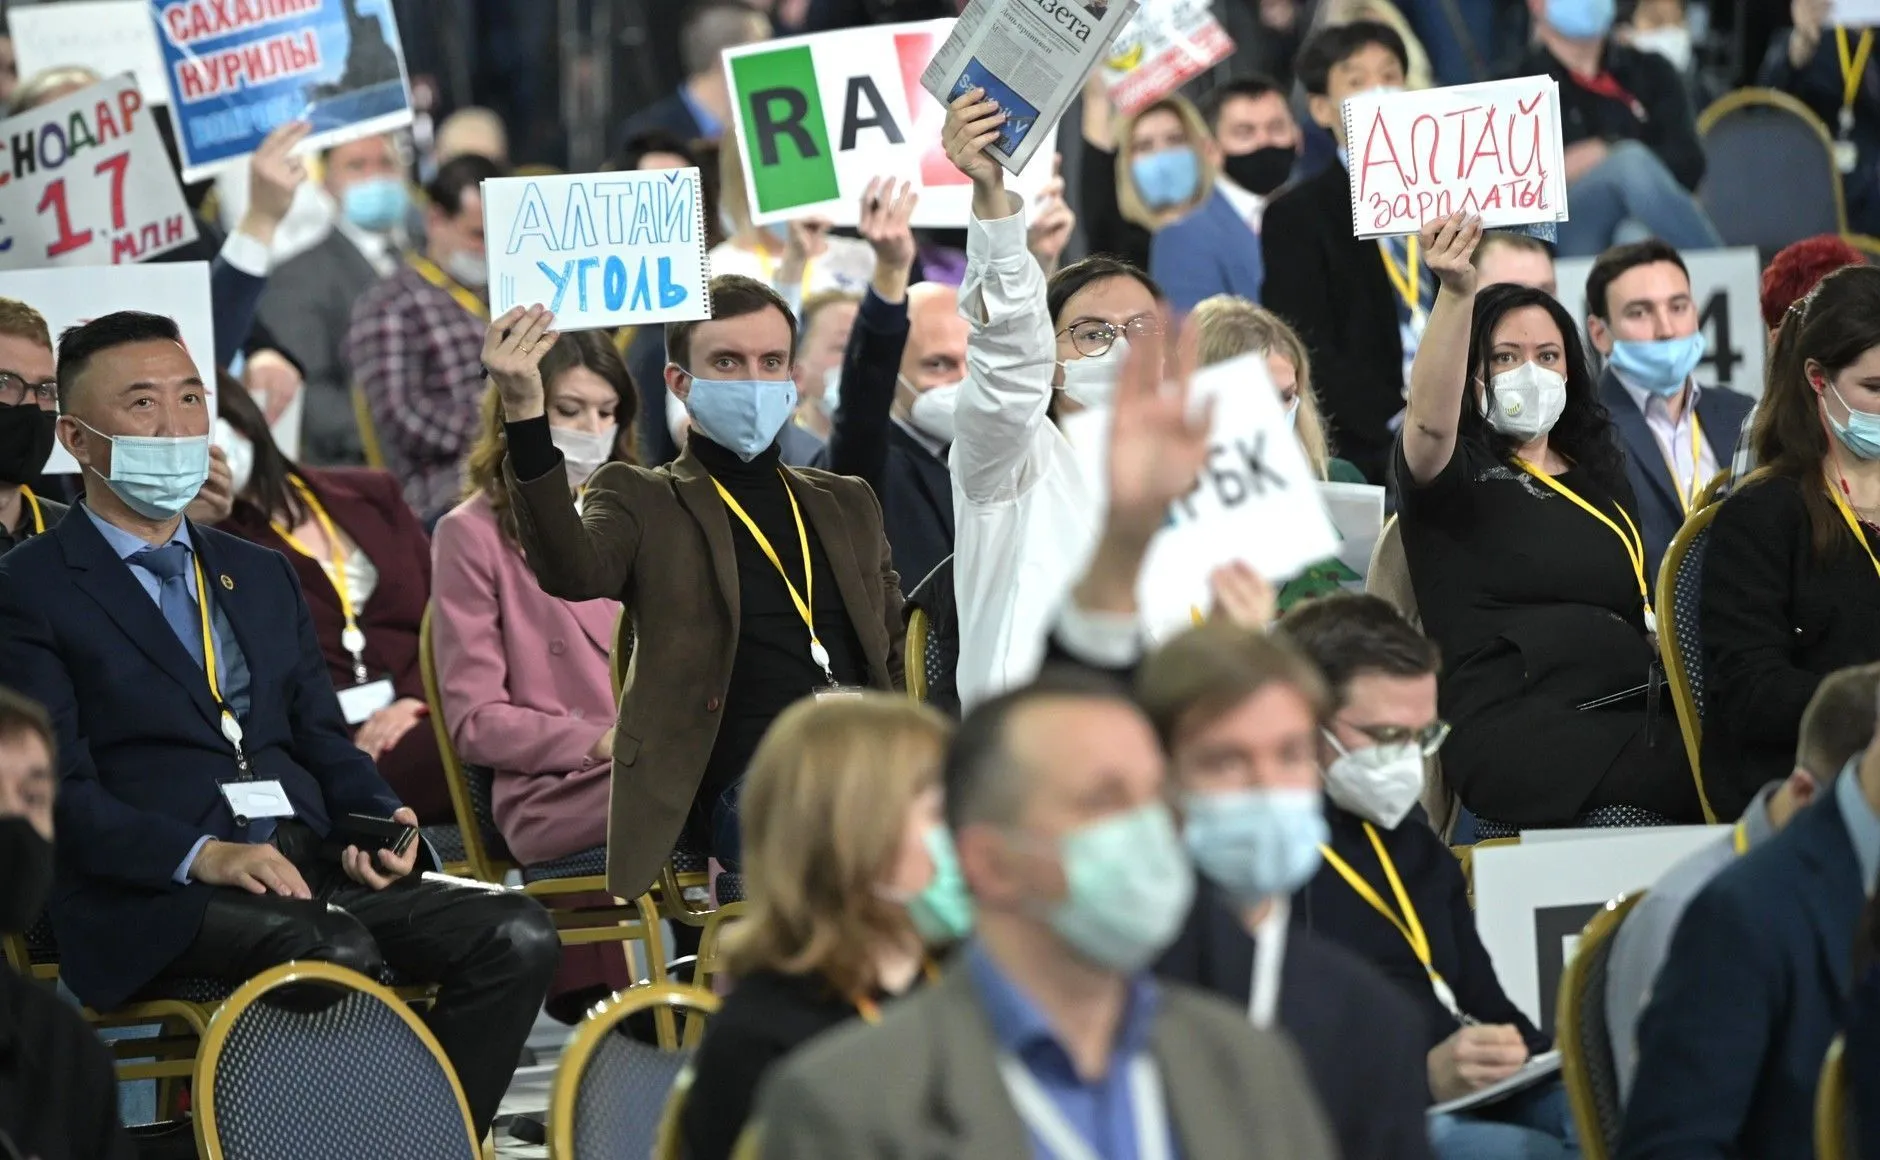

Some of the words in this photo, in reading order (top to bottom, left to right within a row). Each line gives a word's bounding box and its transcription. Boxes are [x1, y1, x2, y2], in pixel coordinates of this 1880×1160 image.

[178, 31, 319, 99] КУРИЛЫ
[0, 89, 142, 187] НОДАР
[1360, 91, 1545, 202] АЛТАЙ
[505, 170, 693, 255] АЛТАЙ
[535, 255, 689, 314] УГОЛЬ
